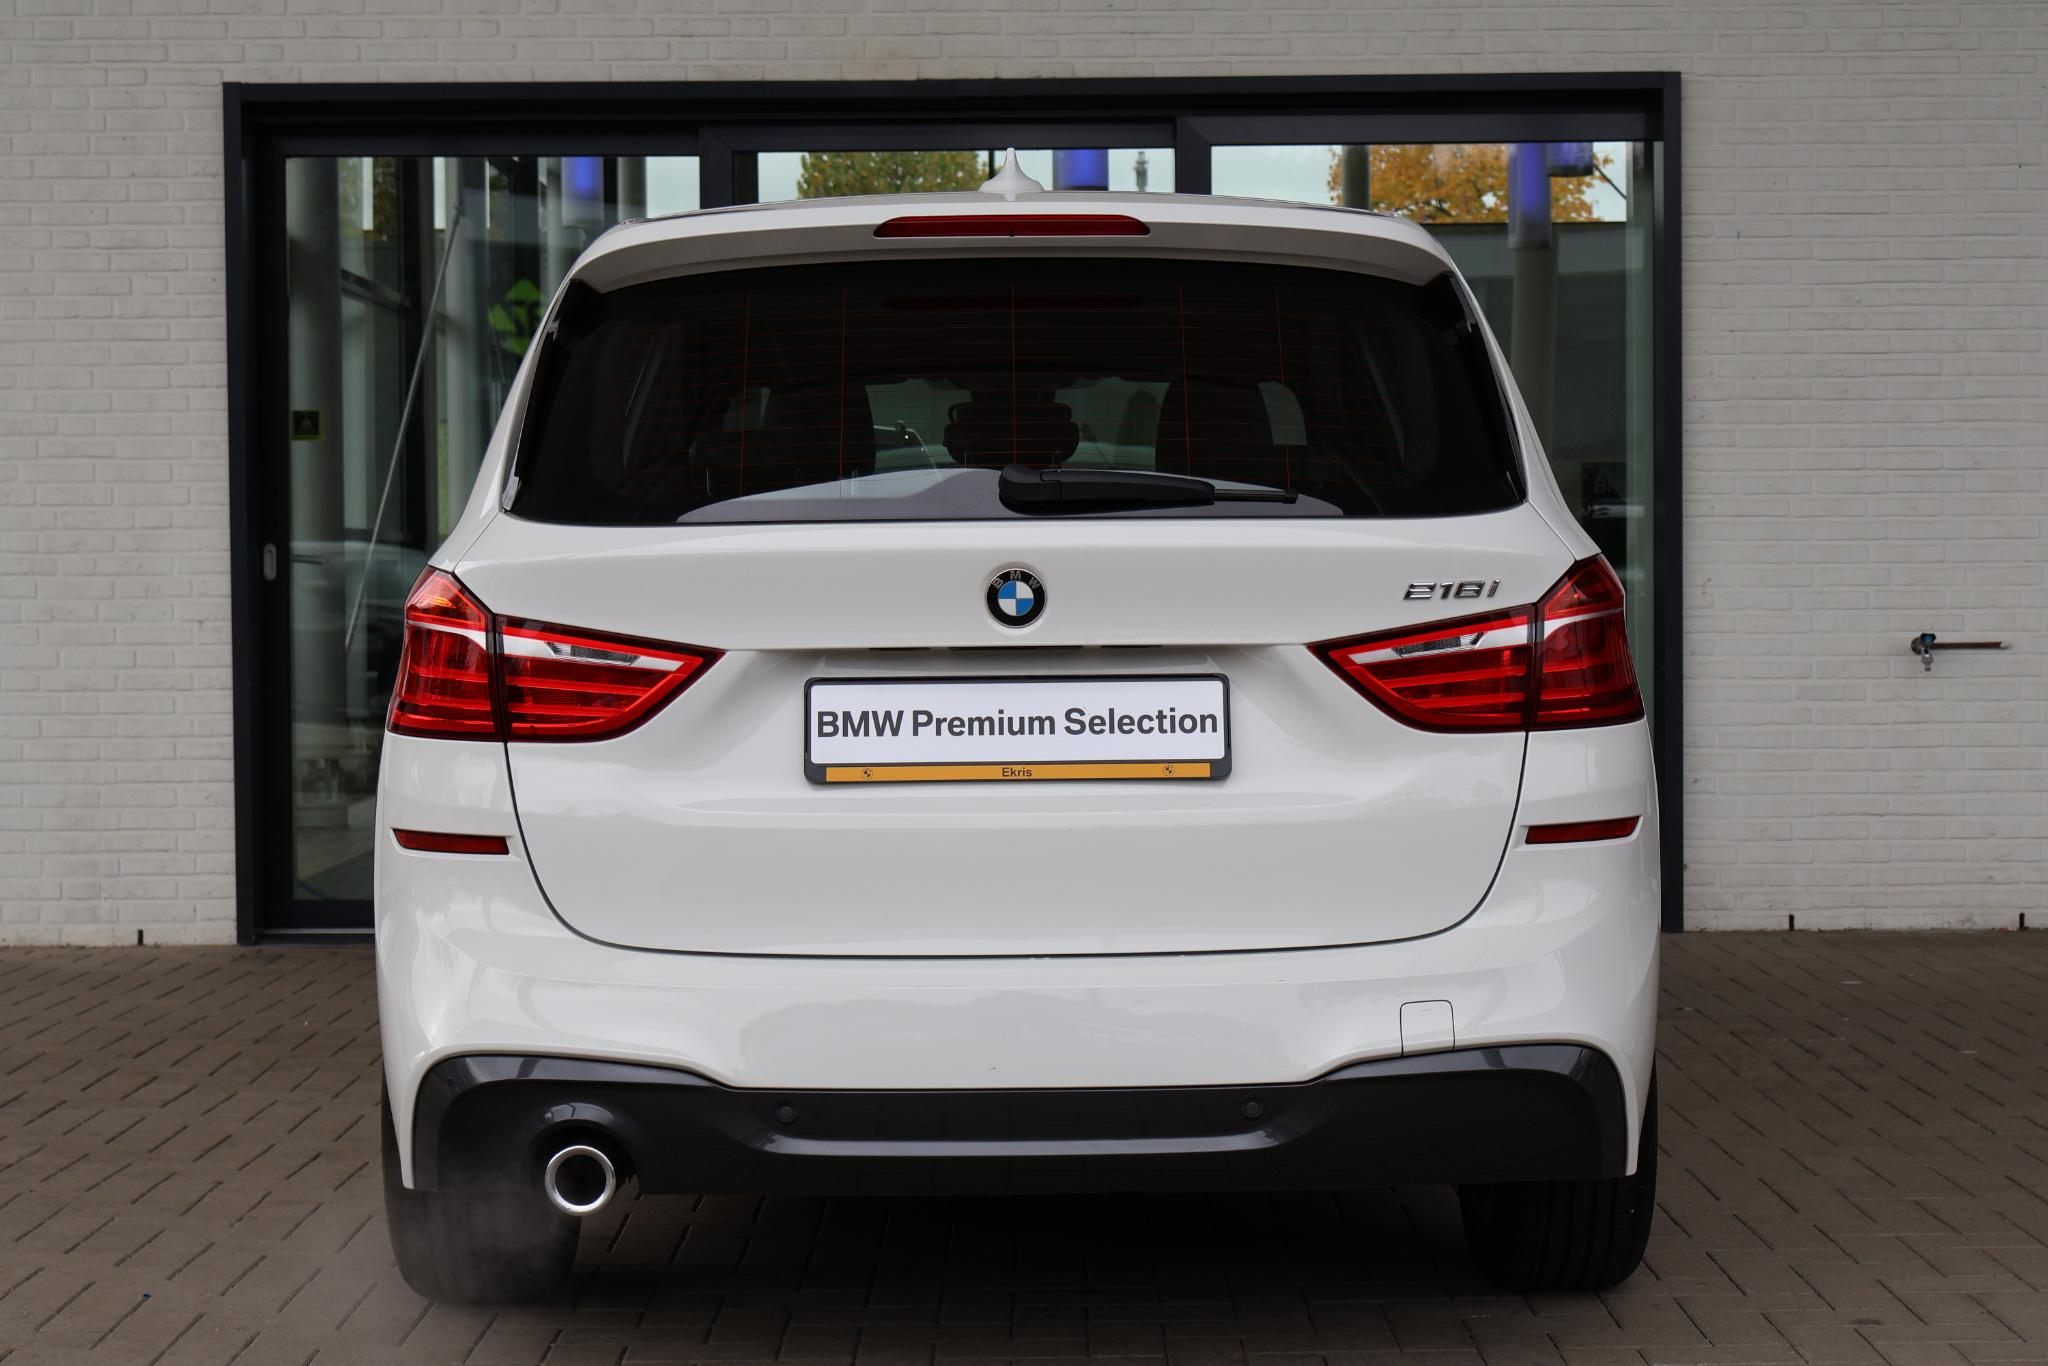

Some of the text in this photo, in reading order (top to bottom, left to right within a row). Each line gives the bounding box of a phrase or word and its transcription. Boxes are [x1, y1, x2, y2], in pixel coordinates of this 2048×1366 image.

[991, 570, 1041, 590] BMW
[817, 707, 1218, 738] BMW Premium Selection
[1002, 767, 1032, 777] Ekris
